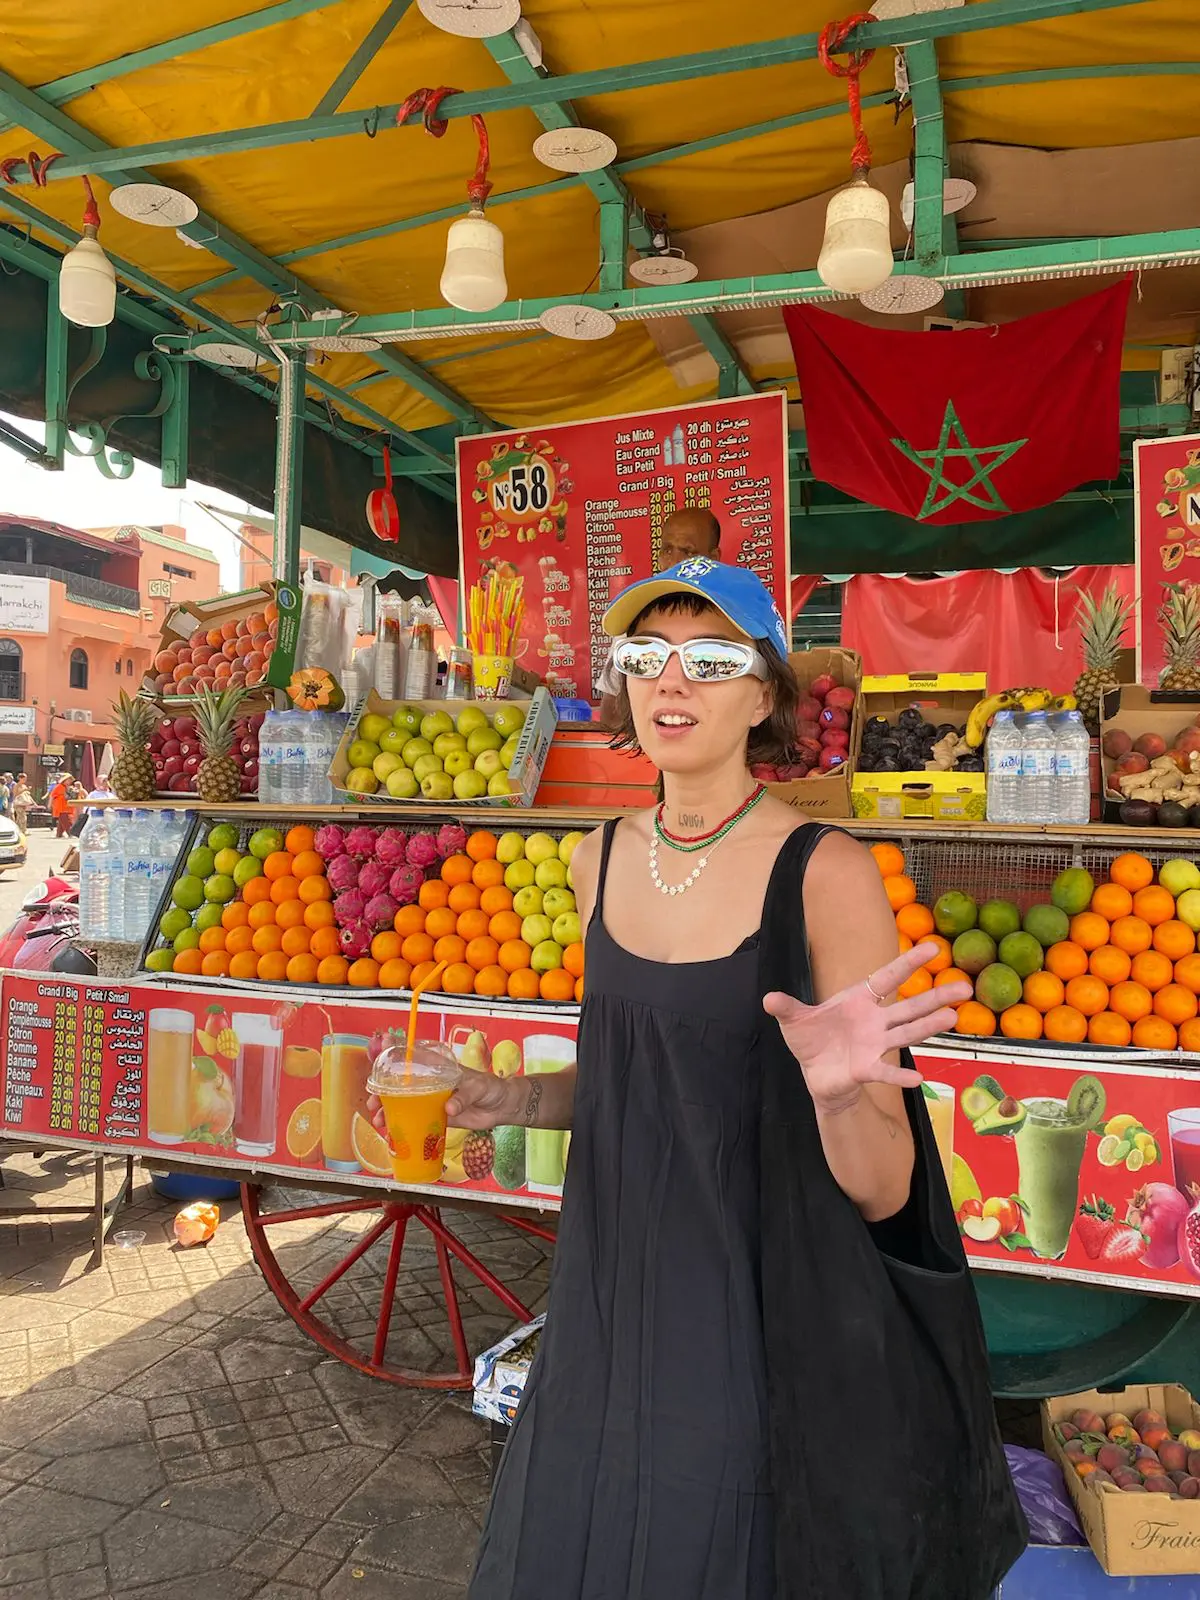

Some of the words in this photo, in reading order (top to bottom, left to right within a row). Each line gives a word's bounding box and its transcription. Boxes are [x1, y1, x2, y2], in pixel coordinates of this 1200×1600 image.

[687, 423, 698, 435] 20
[700, 421, 712, 434] dh
[615, 433, 631, 445] Jus
[632, 428, 655, 442] Mixte
[687, 439, 698, 450] 10
[700, 437, 712, 449] dh
[615, 449, 632, 461] Eau
[634, 444, 660, 458] Grand
[687, 454, 698, 466] 05
[700, 452, 712, 465] dh
[616, 464, 633, 475] Eau
[634, 460, 655, 473] Petit
[685, 471, 708, 484] Petit
[716, 465, 746, 479] Small
[619, 479, 649, 493] Grand
[656, 476, 674, 489] Big
[650, 493, 661, 503] 20
[663, 490, 675, 502] dh
[684, 487, 695, 498] 10
[697, 485, 710, 497] dh
[584, 499, 619, 512] Orange
[650, 504, 661, 514] 20
[664, 503, 676, 513] dh
[698, 497, 710, 508] dh
[586, 522, 615, 533] Citron
[651, 516, 662, 526] 20
[586, 533, 622, 545] Pomme
[651, 527, 662, 537] 20
[587, 545, 622, 556] Banane
[652, 538, 662, 549] 20
[587, 565, 632, 578] Pruneaux
[588, 579, 609, 589] Kaki
[588, 589, 609, 600] Kiwi
[525, 701, 540, 731] GIRONA
[514, 734, 530, 765] FRUITS
[38, 984, 61, 997] Grand
[65, 986, 78, 1001] Big
[108, 991, 130, 1004] Small
[9, 997, 38, 1015] Orange
[55, 1002, 65, 1015] 20
[66, 1003, 76, 1017] dh
[83, 1005, 93, 1018] 10
[94, 1006, 104, 1020] dh
[8, 1026, 32, 1040] Citron
[55, 1017, 64, 1029] 20
[66, 1017, 76, 1031] dh
[83, 1020, 92, 1033] 10
[93, 1021, 104, 1034] dh
[8, 1040, 37, 1055] Pomme
[54, 1031, 64, 1043] 20
[65, 1032, 75, 1045] dh
[82, 1034, 91, 1047] 10
[92, 1035, 102, 1049] dh
[7, 1053, 37, 1069] Banane
[54, 1045, 64, 1057] 20
[65, 1046, 75, 1058] dh
[82, 1048, 90, 1060] 10
[92, 1049, 102, 1062] dh
[53, 1058, 63, 1071] 20
[64, 1060, 74, 1073] dh
[81, 1062, 90, 1075] 10
[91, 1063, 101, 1076] dh
[6, 1081, 44, 1097] Pruneaux
[53, 1072, 62, 1085] 20
[63, 1074, 74, 1087] dh
[80, 1076, 89, 1089] 10
[90, 1077, 101, 1091] dh
[5, 1095, 23, 1108] Kaki
[52, 1086, 61, 1099] 20
[63, 1088, 73, 1100] dh
[80, 1090, 89, 1103] 10
[90, 1091, 100, 1105] dh
[5, 1108, 22, 1122] Kiwi
[51, 1100, 61, 1113] 20
[62, 1102, 72, 1115] dh
[79, 1104, 88, 1117] 10
[89, 1105, 100, 1119] dh
[50, 1115, 60, 1127] 20
[61, 1116, 71, 1129] dh
[78, 1119, 88, 1132] 10
[88, 1120, 99, 1134] dh
